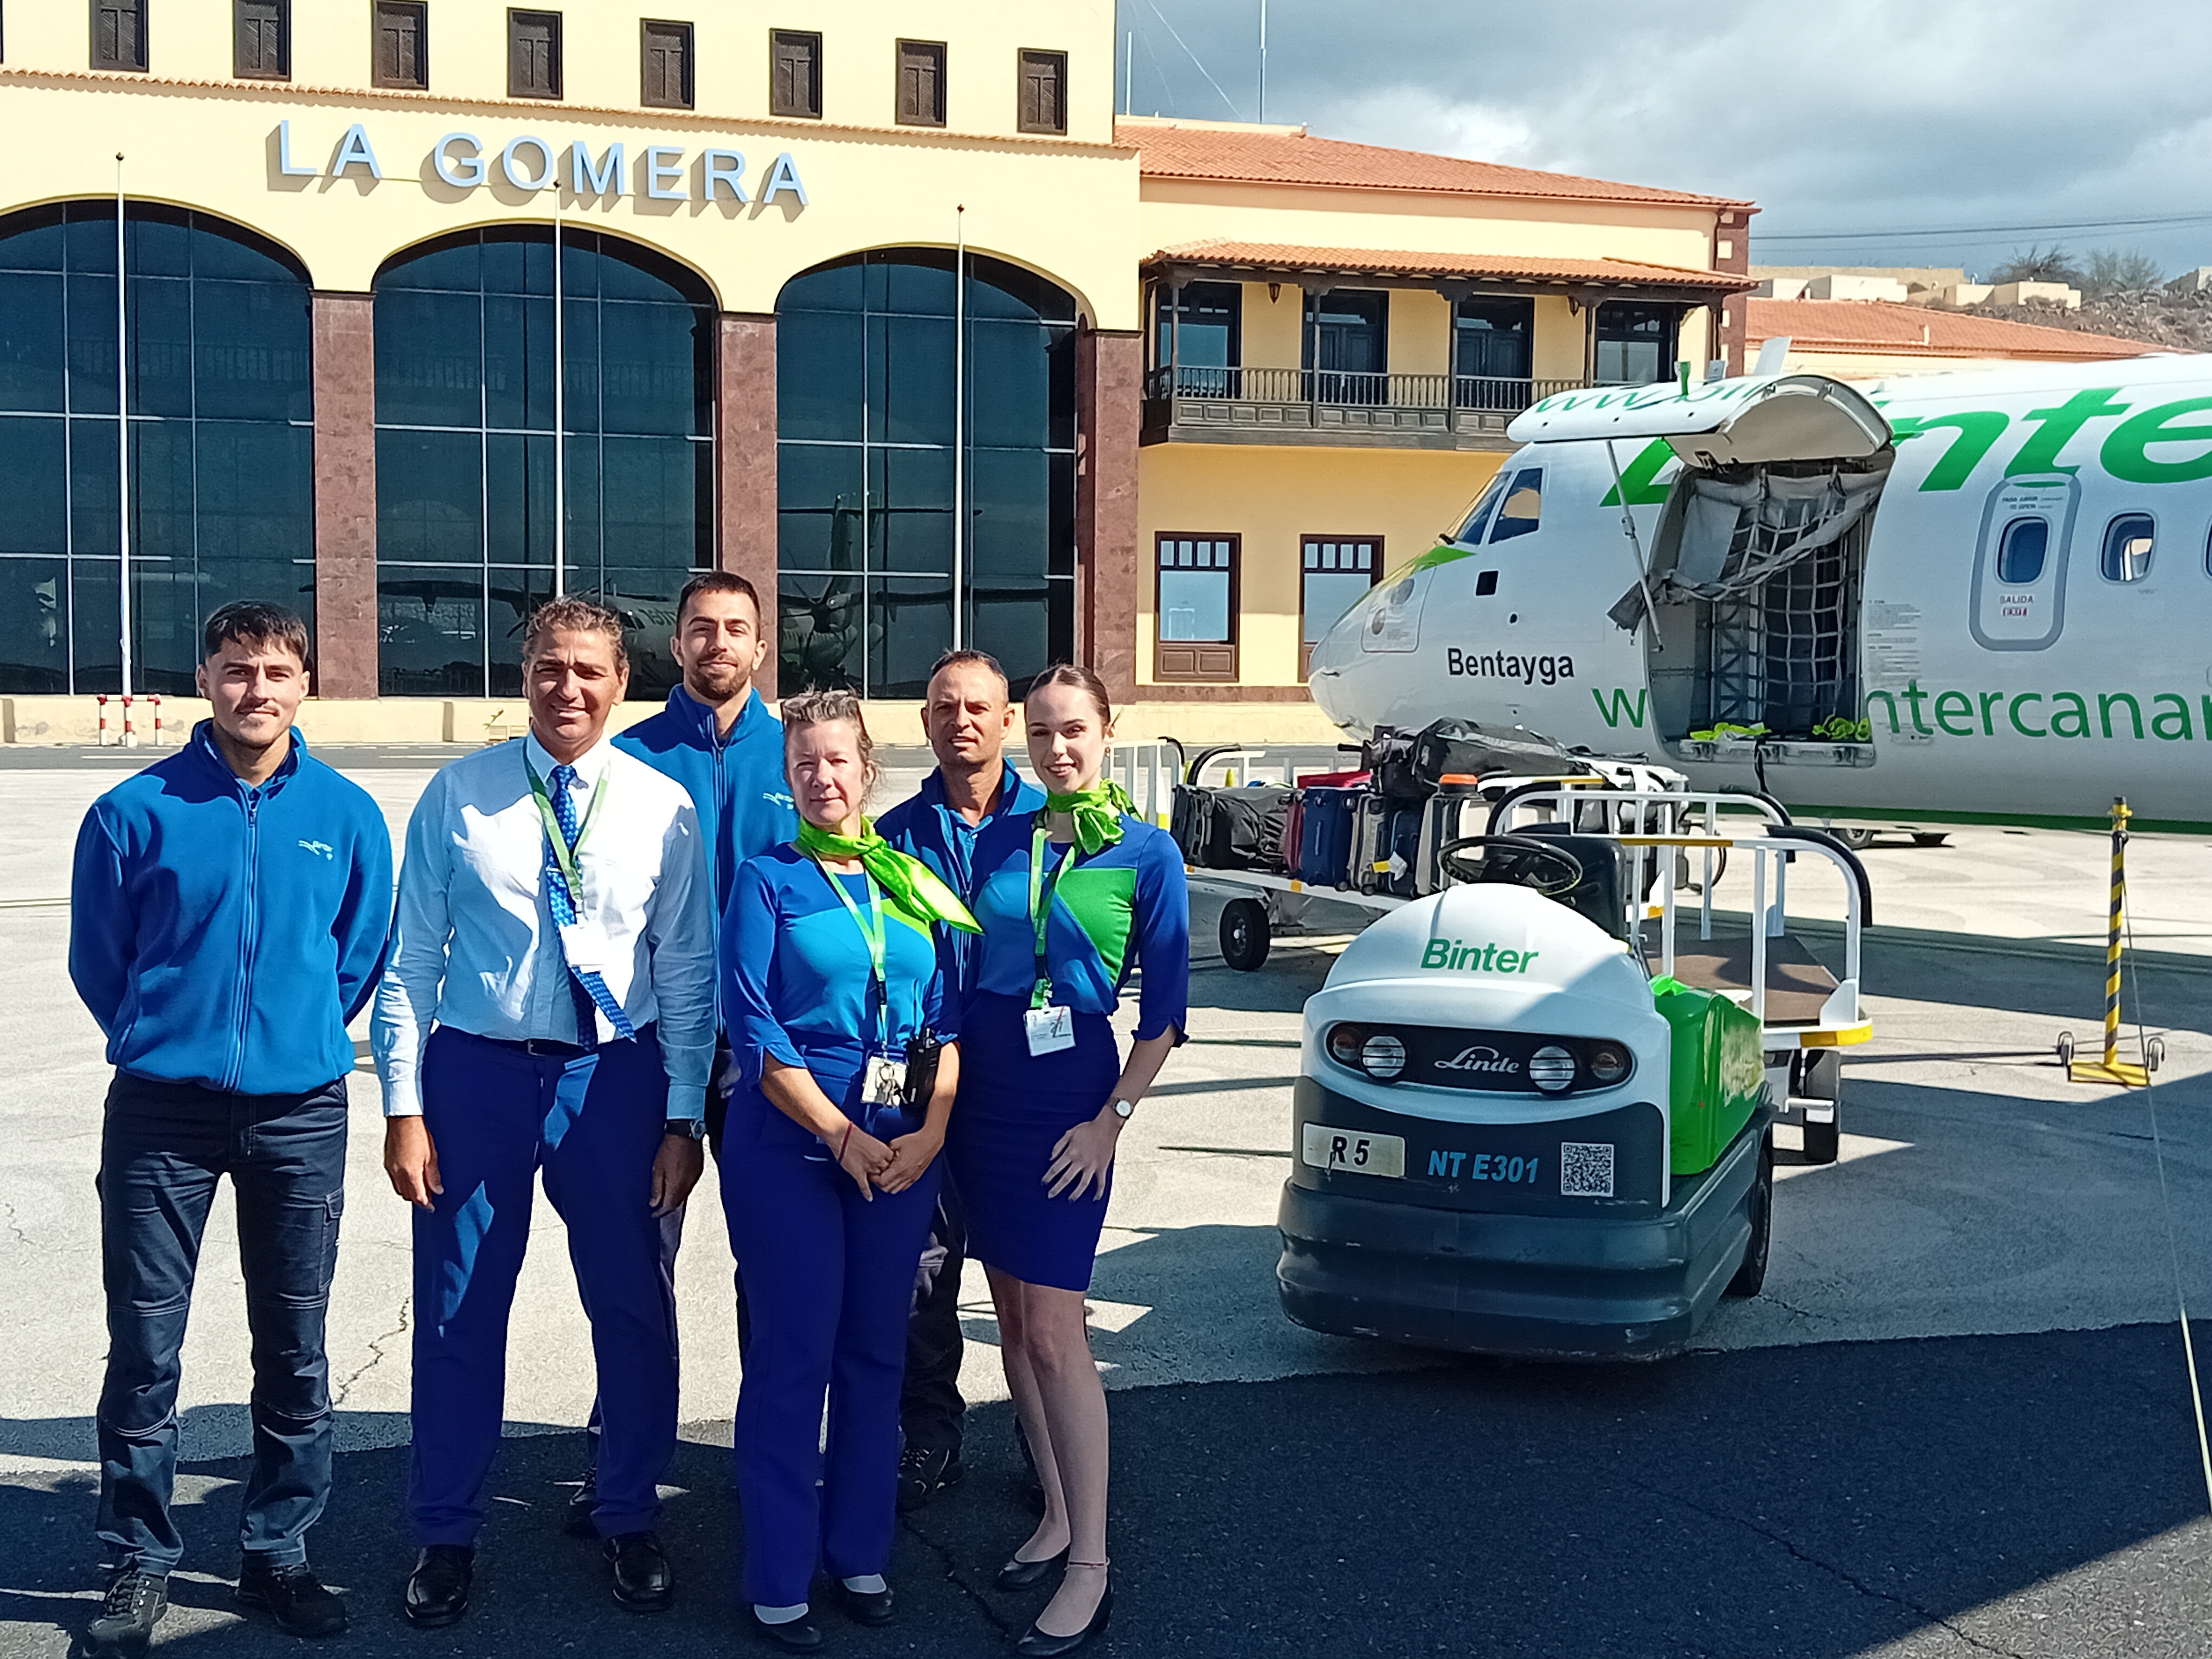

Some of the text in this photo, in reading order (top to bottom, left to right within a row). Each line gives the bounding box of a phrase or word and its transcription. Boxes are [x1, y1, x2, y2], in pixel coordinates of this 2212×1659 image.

[280, 119, 808, 205] LA GOMERA
[1999, 595, 2034, 604] SALIDA
[1448, 647, 1575, 686] Bentayga
[1421, 938, 1540, 974] Binter
[1434, 1046, 1520, 1073] Linde
[1332, 1136, 1370, 1166] R 5
[1427, 1150, 1539, 1184] NT E301
